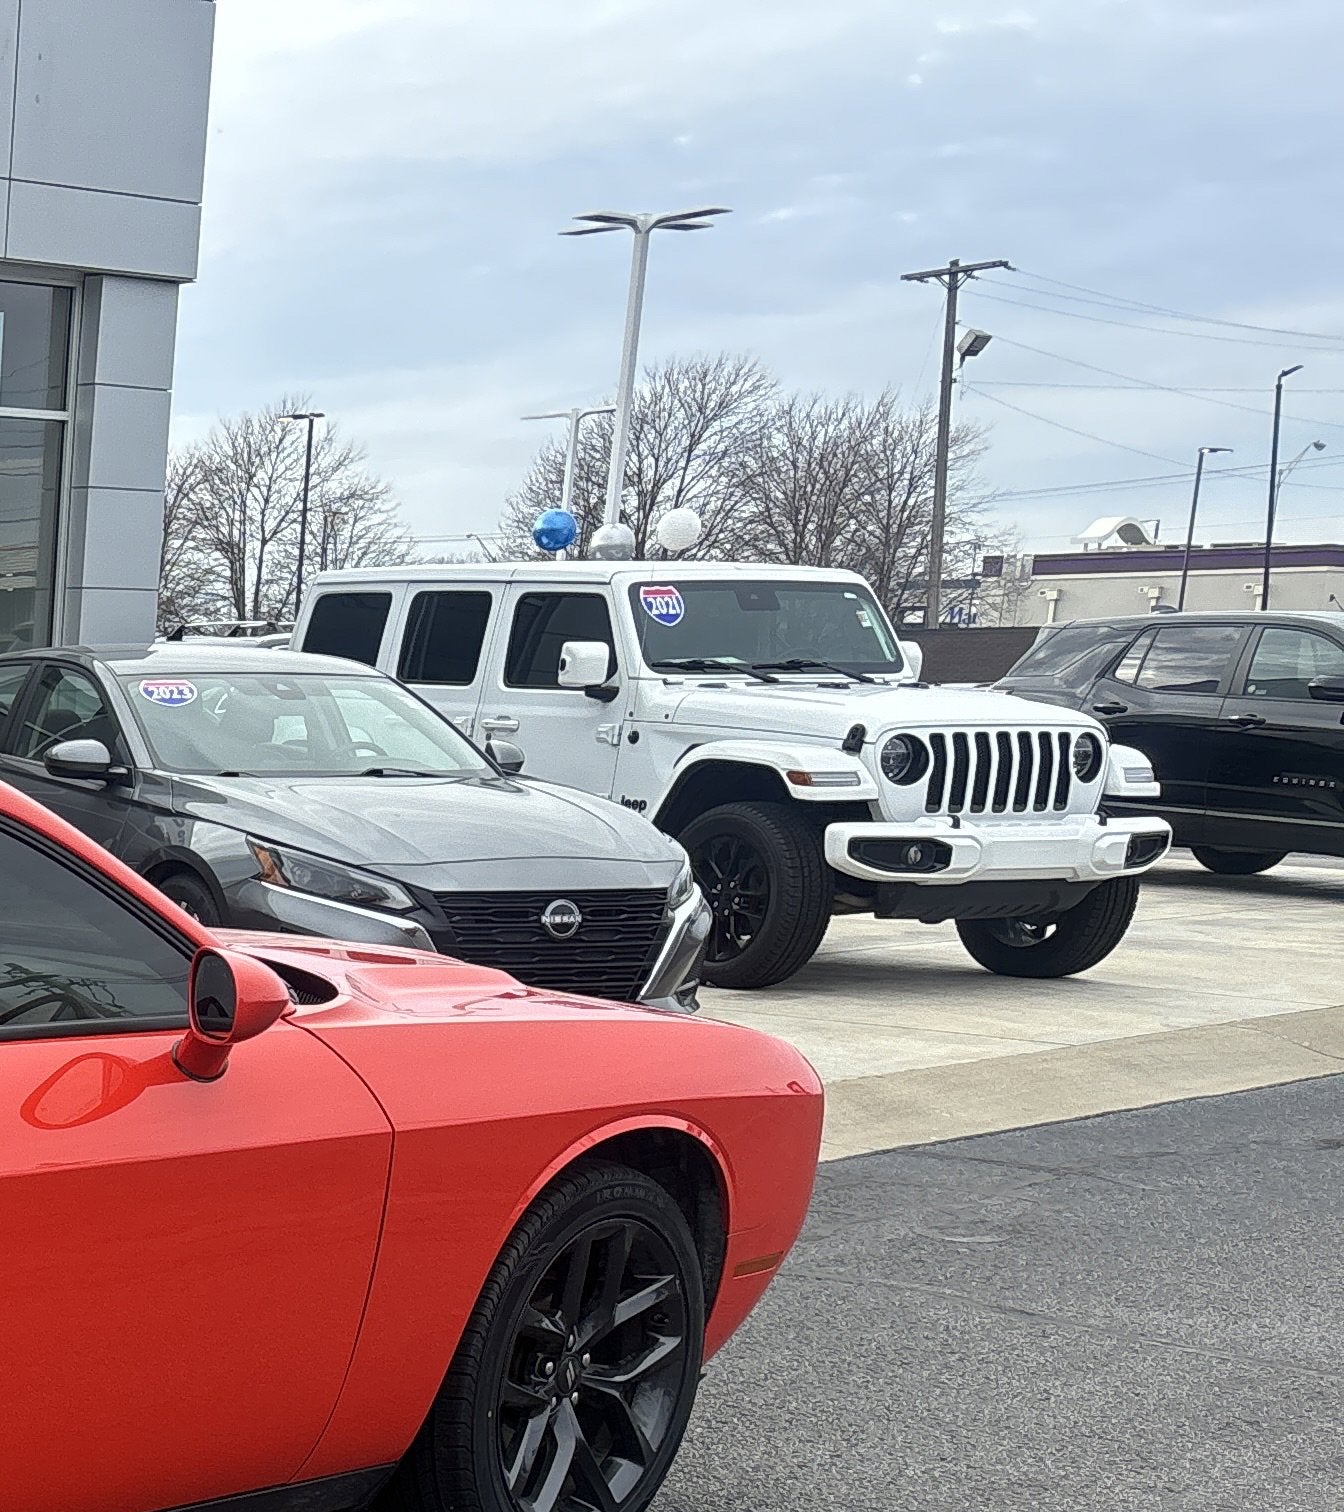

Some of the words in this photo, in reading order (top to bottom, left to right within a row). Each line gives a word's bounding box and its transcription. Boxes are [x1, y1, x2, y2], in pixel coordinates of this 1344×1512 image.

[646, 596, 681, 614] 2021
[147, 686, 193, 699] 2023
[620, 794, 648, 814] Jeep
[540, 913, 583, 924] NISSAN
